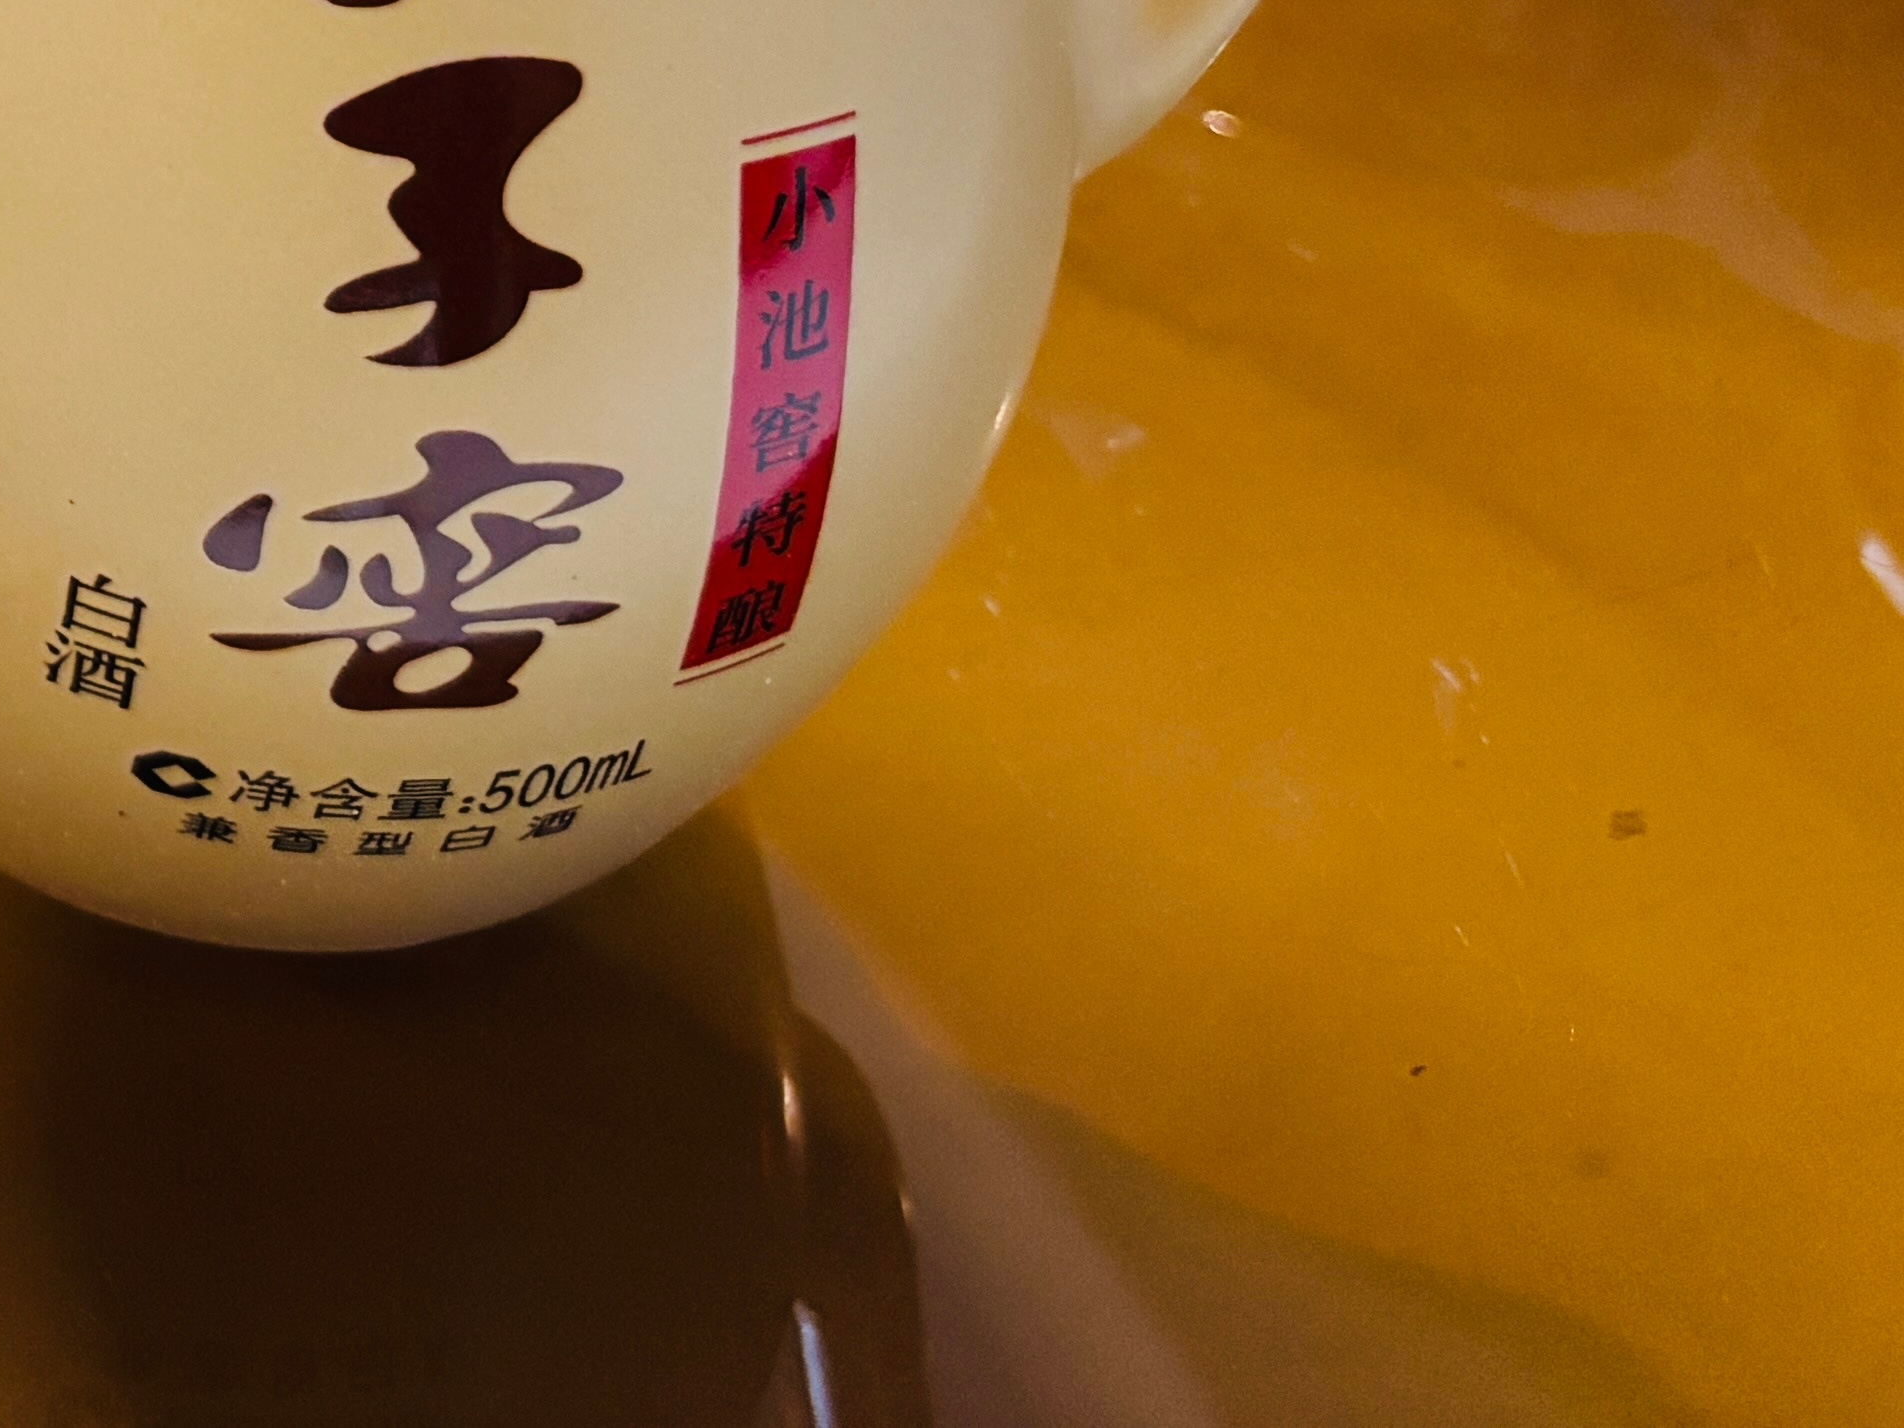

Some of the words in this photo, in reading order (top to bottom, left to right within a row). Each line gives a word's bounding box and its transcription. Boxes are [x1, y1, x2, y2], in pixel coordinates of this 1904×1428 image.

[705, 164, 836, 656] 小池窖特酿
[44, 573, 148, 709] 白酒
[176, 805, 583, 856] 兼香型白酒
